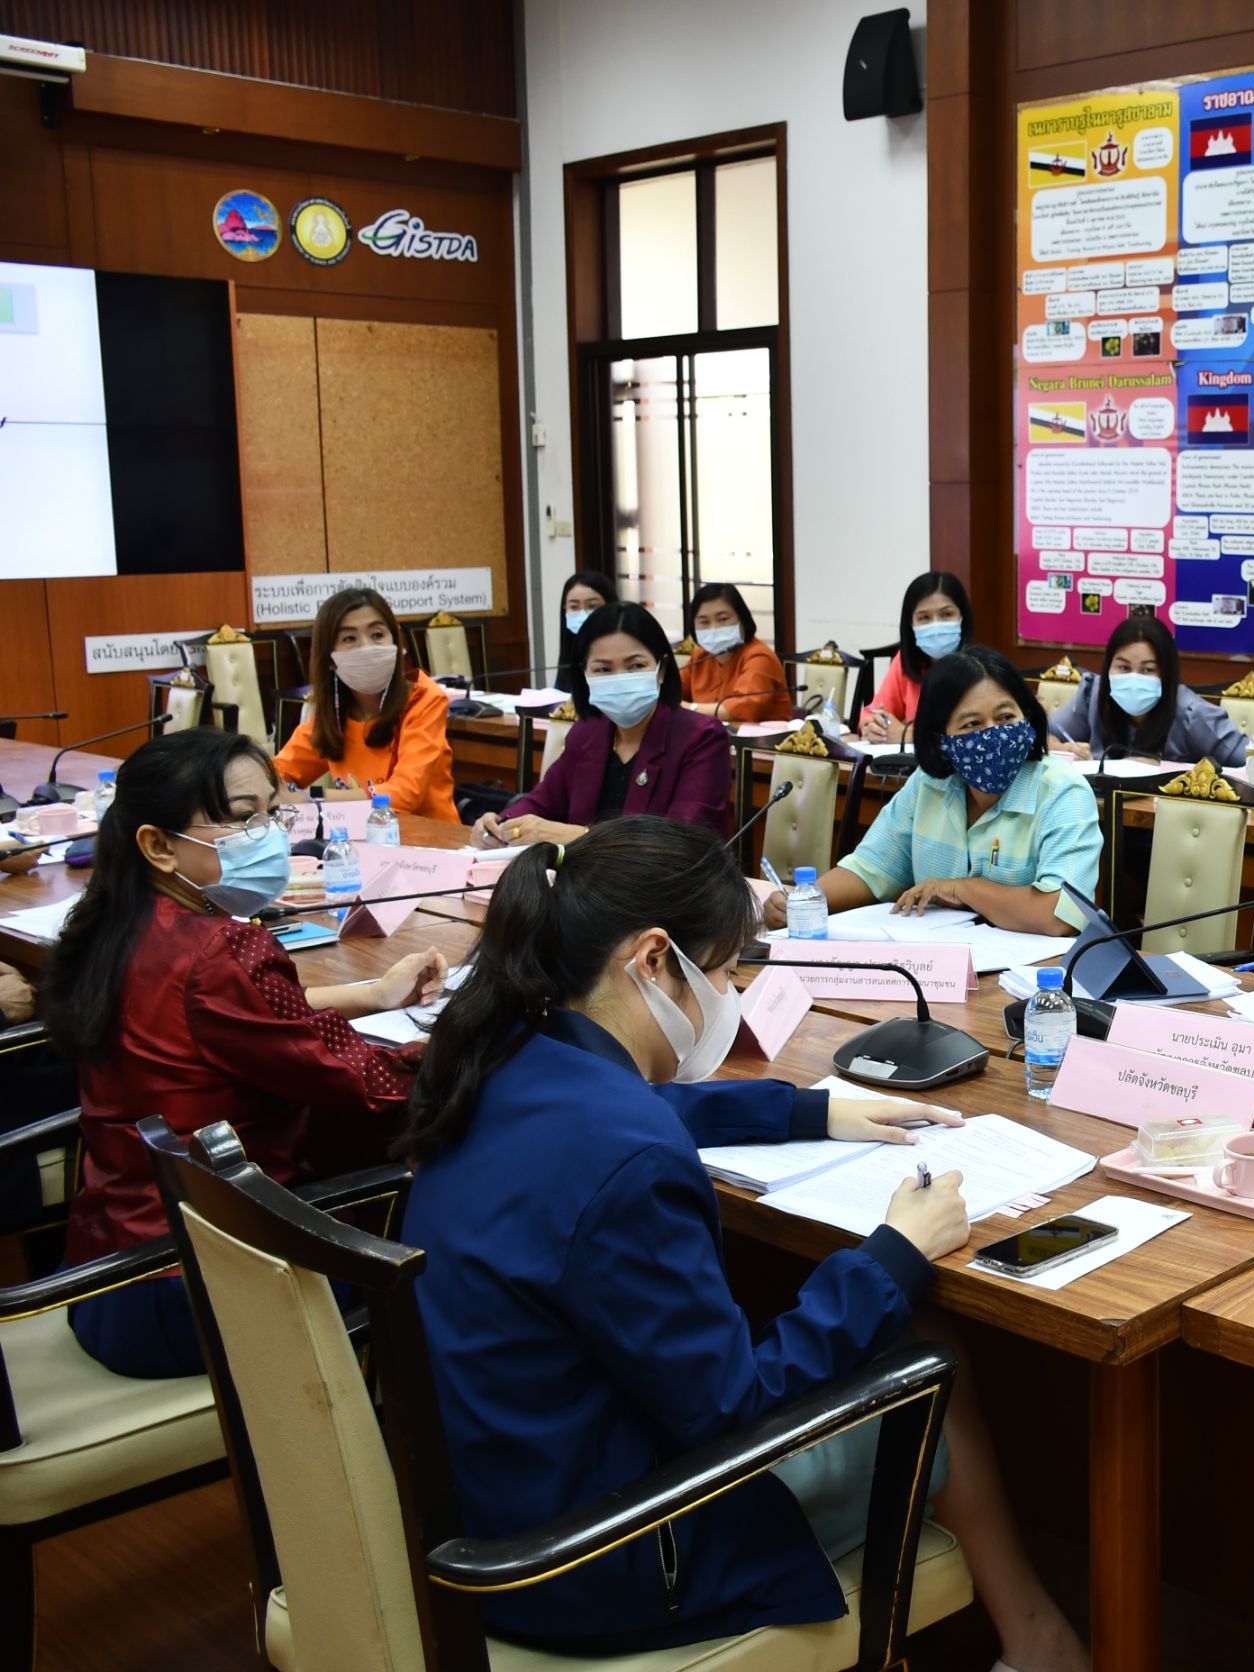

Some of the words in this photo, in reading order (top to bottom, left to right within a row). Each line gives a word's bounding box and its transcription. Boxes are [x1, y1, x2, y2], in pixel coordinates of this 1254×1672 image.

[1029, 377, 1065, 392] Negara
[1068, 376, 1104, 389] Brunei
[1108, 374, 1171, 388] Darussalam
[1198, 371, 1252, 388] Kingdom
[256, 600, 310, 616] (Holistic
[438, 594, 487, 609] System)
[93, 639, 178, 662] สนับสนุนโดย
[1172, 1032, 1228, 1050] นายประเมิน
[1232, 1042, 1252, 1056] อุมา
[1117, 1070, 1199, 1103] ปลัดจังหวัดชลบุรี
